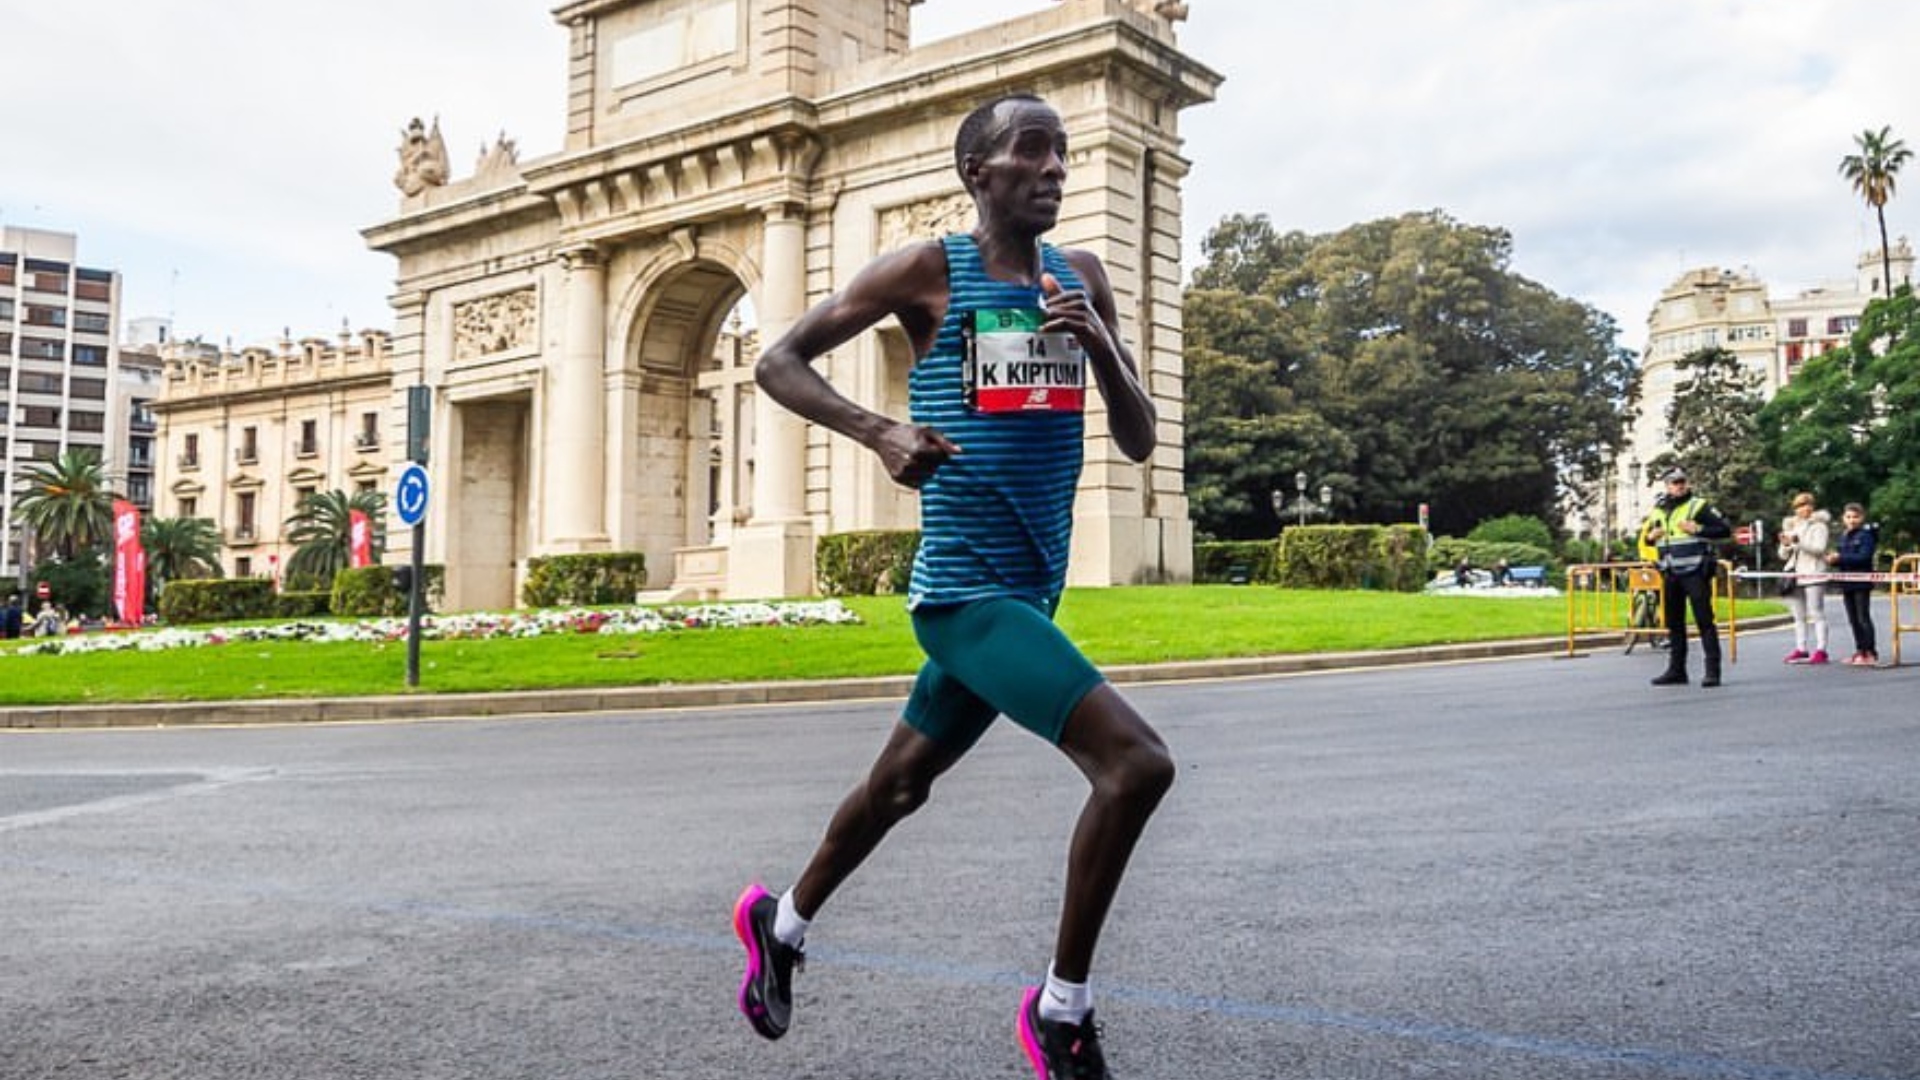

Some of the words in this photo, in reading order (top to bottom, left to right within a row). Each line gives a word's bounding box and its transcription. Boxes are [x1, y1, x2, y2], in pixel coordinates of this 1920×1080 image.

[1027, 337, 1046, 357] 14
[983, 363, 998, 385] K
[1007, 362, 1078, 385] KIPTUM
